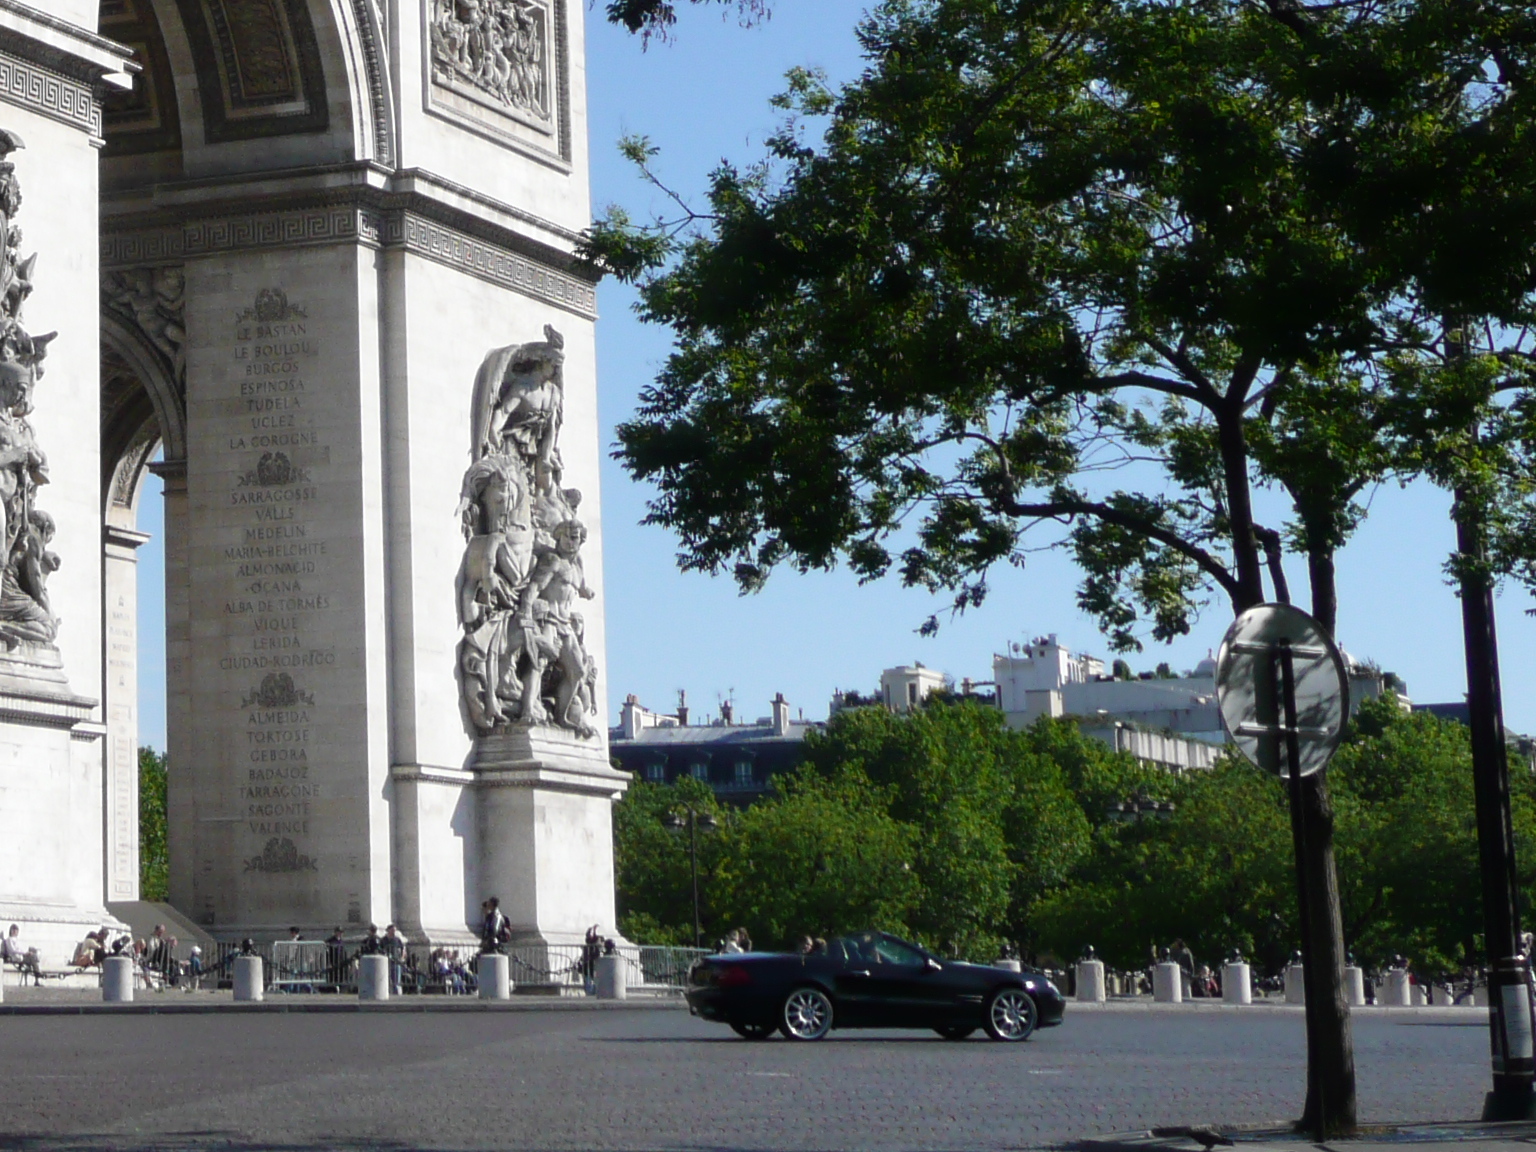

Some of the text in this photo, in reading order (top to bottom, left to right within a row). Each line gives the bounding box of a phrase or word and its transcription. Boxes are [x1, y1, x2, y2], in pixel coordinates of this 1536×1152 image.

[236, 323, 307, 341] LE BASTAN
[234, 341, 310, 359] LE BOULOU
[246, 361, 299, 376] BURGOS
[240, 379, 305, 396] ESPINOSA
[246, 397, 301, 412] TUDELA
[251, 414, 296, 429] UCLEZ
[230, 432, 319, 450] LA COROGNE
[231, 487, 318, 505] SARRAGOSSE
[256, 506, 295, 521] VALLS
[237, 561, 316, 578] ALMONACID
[224, 600, 253, 614] ALBA
[257, 600, 273, 613] DE
[252, 635, 301, 650] LERIDA
[248, 710, 310, 725] ALMEIDA
[246, 729, 310, 744] TORTOSE
[249, 767, 309, 781] BADAJOZ
[239, 784, 320, 799] TARRAGONE
[248, 802, 311, 816] SAGONTE
[249, 820, 309, 835] VALENCE
